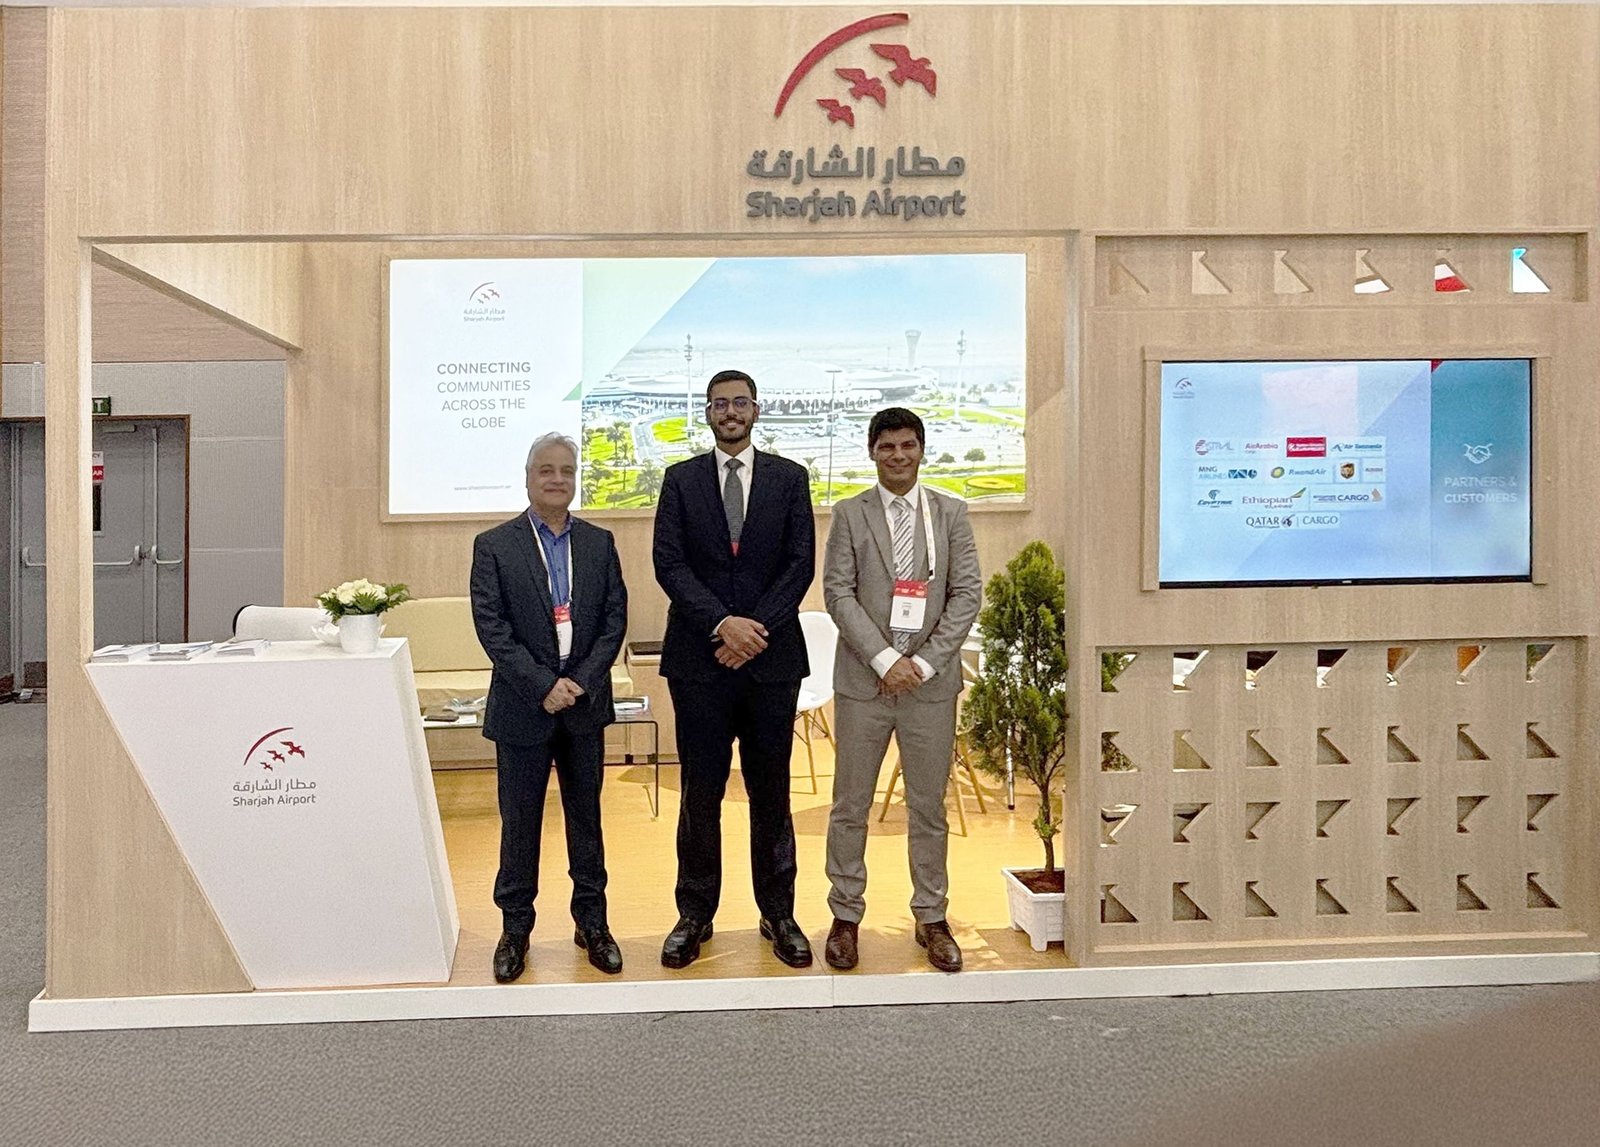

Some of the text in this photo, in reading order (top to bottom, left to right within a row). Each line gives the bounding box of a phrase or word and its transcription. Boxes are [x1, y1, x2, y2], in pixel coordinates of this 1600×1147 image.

[746, 143, 966, 185] مطار الشارقة
[746, 187, 967, 222] Sharjah Airport
[437, 361, 531, 375] CONNECTING
[437, 379, 531, 393] COMMUNITIES
[441, 397, 526, 412] ACROSS THE
[461, 416, 507, 429] GLOBE
[1444, 476, 1518, 488] PARTNERS &
[1242, 496, 1293, 506] Ethiopian
[1337, 494, 1370, 502] CARGO
[1444, 492, 1518, 504] CUSTOMERS
[1245, 515, 1338, 527] QATAR CARGO
[232, 778, 317, 794] مطار الشارقة
[232, 793, 316, 808] Sharjah Airport
